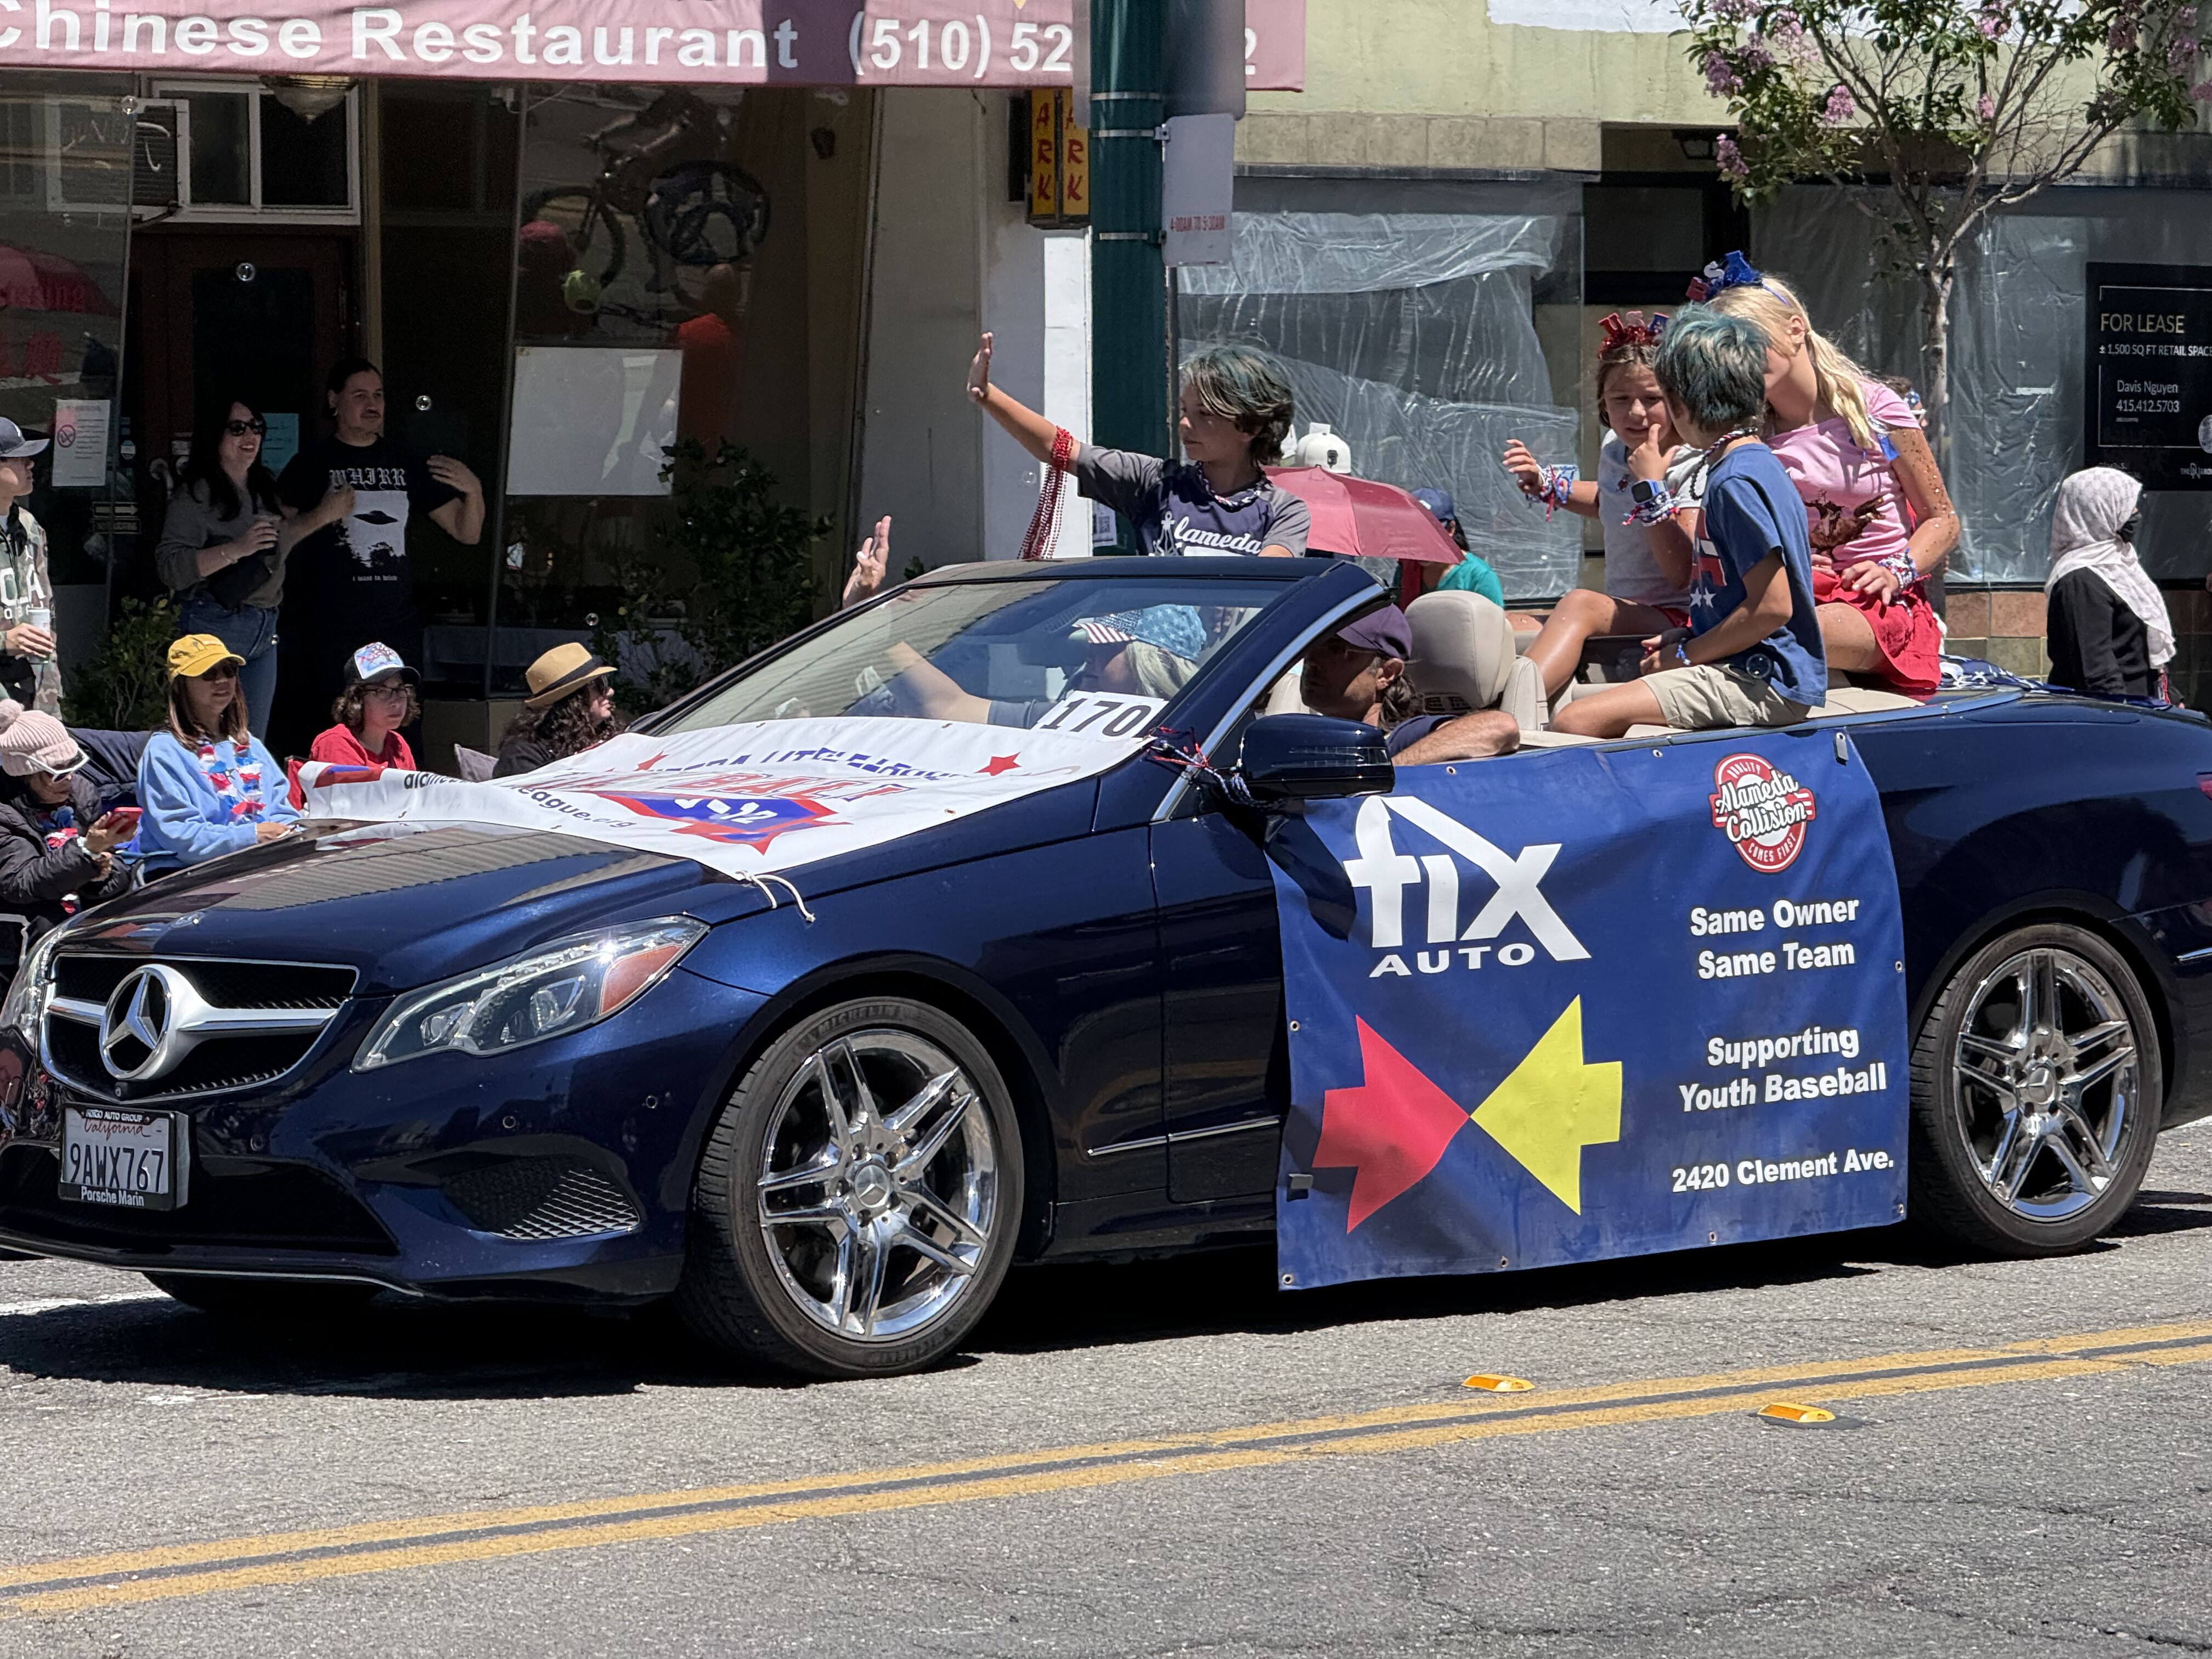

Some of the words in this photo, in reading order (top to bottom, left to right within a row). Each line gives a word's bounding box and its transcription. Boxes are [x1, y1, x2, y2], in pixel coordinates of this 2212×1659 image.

[351, 8, 799, 69] Restaurant
[849, 11, 991, 78] (510)
[2101, 313, 2134, 332] FOR
[2138, 314, 2186, 334] LEASE
[2132, 345, 2145, 357] SQ
[2146, 345, 2157, 355] FT
[2158, 346, 2186, 356] RETAIL
[2116, 399, 2180, 413] 415.412.5703
[2117, 380, 2142, 392] Davis
[2144, 381, 2179, 395] Nguyen
[1039, 698, 1152, 737] 170
[1716, 769, 1799, 815] Alameda
[1726, 799, 1807, 842] Collision
[1748, 842, 1775, 862] COMES
[1690, 907, 1765, 936] Same
[1773, 899, 1860, 929] Owner
[1369, 943, 1535, 978] AUTO
[1698, 951, 1776, 980] Same
[1782, 942, 1855, 970] Team
[1707, 1026, 1860, 1069] Supporting
[1679, 1077, 1756, 1112] Youth
[1765, 1062, 1887, 1103] Baseball
[84, 1118, 151, 1141] California
[104, 1111, 120, 1121] AUTO
[121, 1113, 143, 1123] GROUP
[70, 1143, 164, 1193] 9AWX767
[1672, 1164, 1729, 1193] 2420
[1737, 1152, 1838, 1186] Clement
[1843, 1149, 1895, 1173] Ave.
[81, 1186, 117, 1204] Porsche
[119, 1190, 144, 1207] Marin
